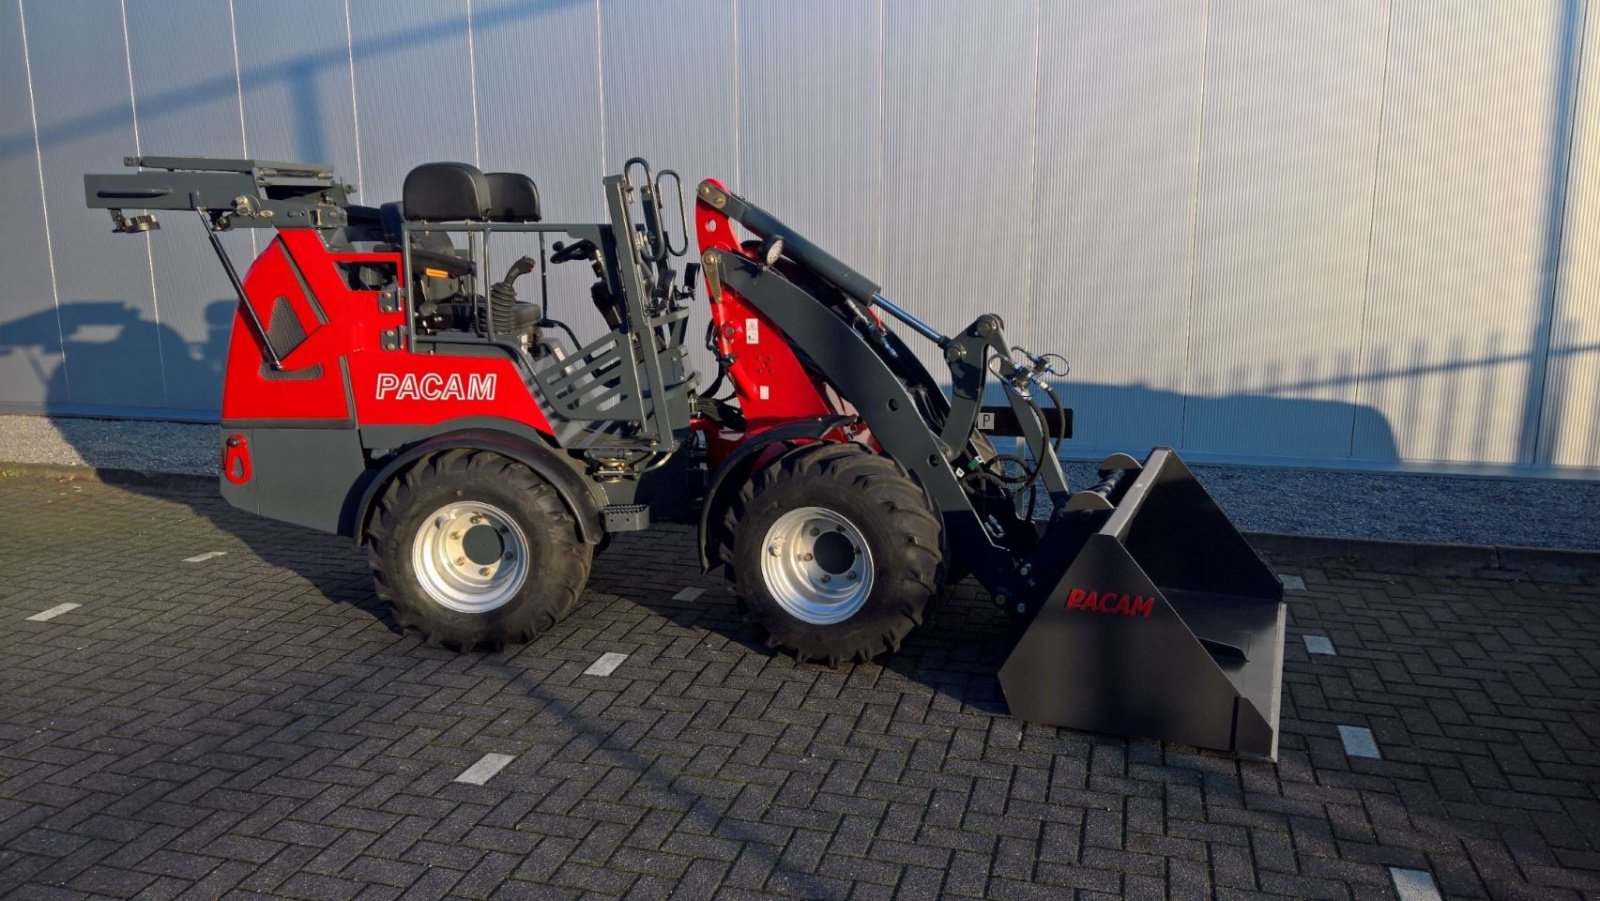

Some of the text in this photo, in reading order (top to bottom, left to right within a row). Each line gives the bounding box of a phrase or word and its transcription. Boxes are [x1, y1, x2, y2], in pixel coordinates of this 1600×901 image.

[376, 373, 497, 400] PACAM
[982, 414, 991, 428] P
[1065, 588, 1155, 618] PACAM
